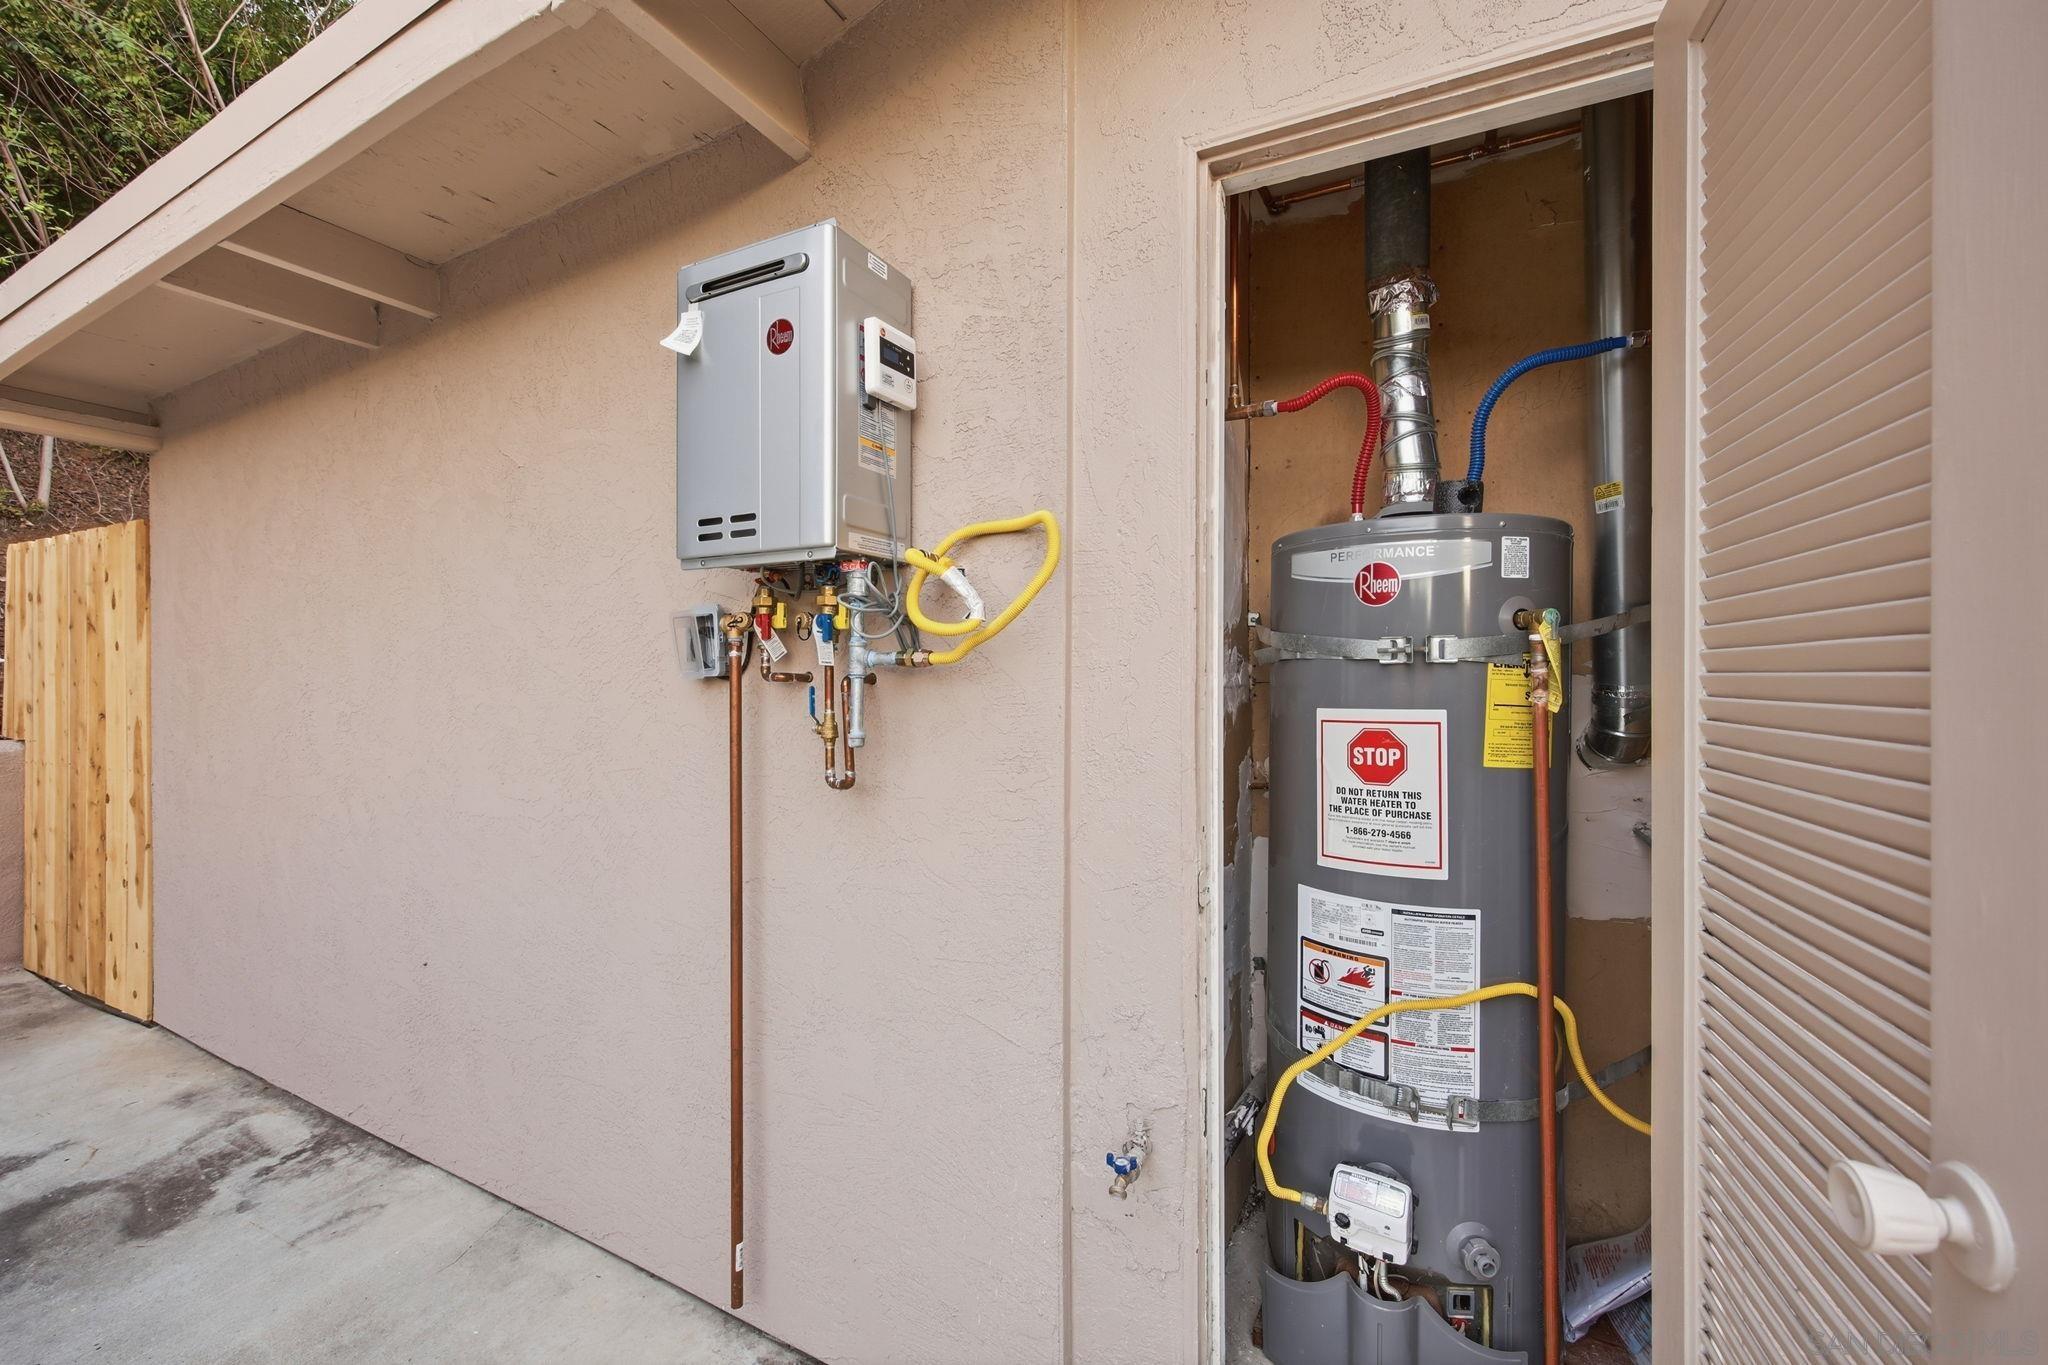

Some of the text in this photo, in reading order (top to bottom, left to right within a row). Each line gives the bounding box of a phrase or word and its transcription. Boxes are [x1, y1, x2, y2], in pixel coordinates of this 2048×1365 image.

[769, 319, 793, 350] Rheem
[1330, 545, 1436, 563] PERFORMANCE
[1359, 562, 1399, 600] Rheem
[1353, 746, 1401, 767] STOP
[1336, 786, 1422, 801] DO NOT RETURN THIS
[1340, 796, 1416, 810] WATER HEATER TO
[1329, 804, 1432, 821] THE PLACE OF PURCHASE
[1345, 826, 1411, 840] 1-866-279-4566
[1328, 950, 1359, 962] WARNING
